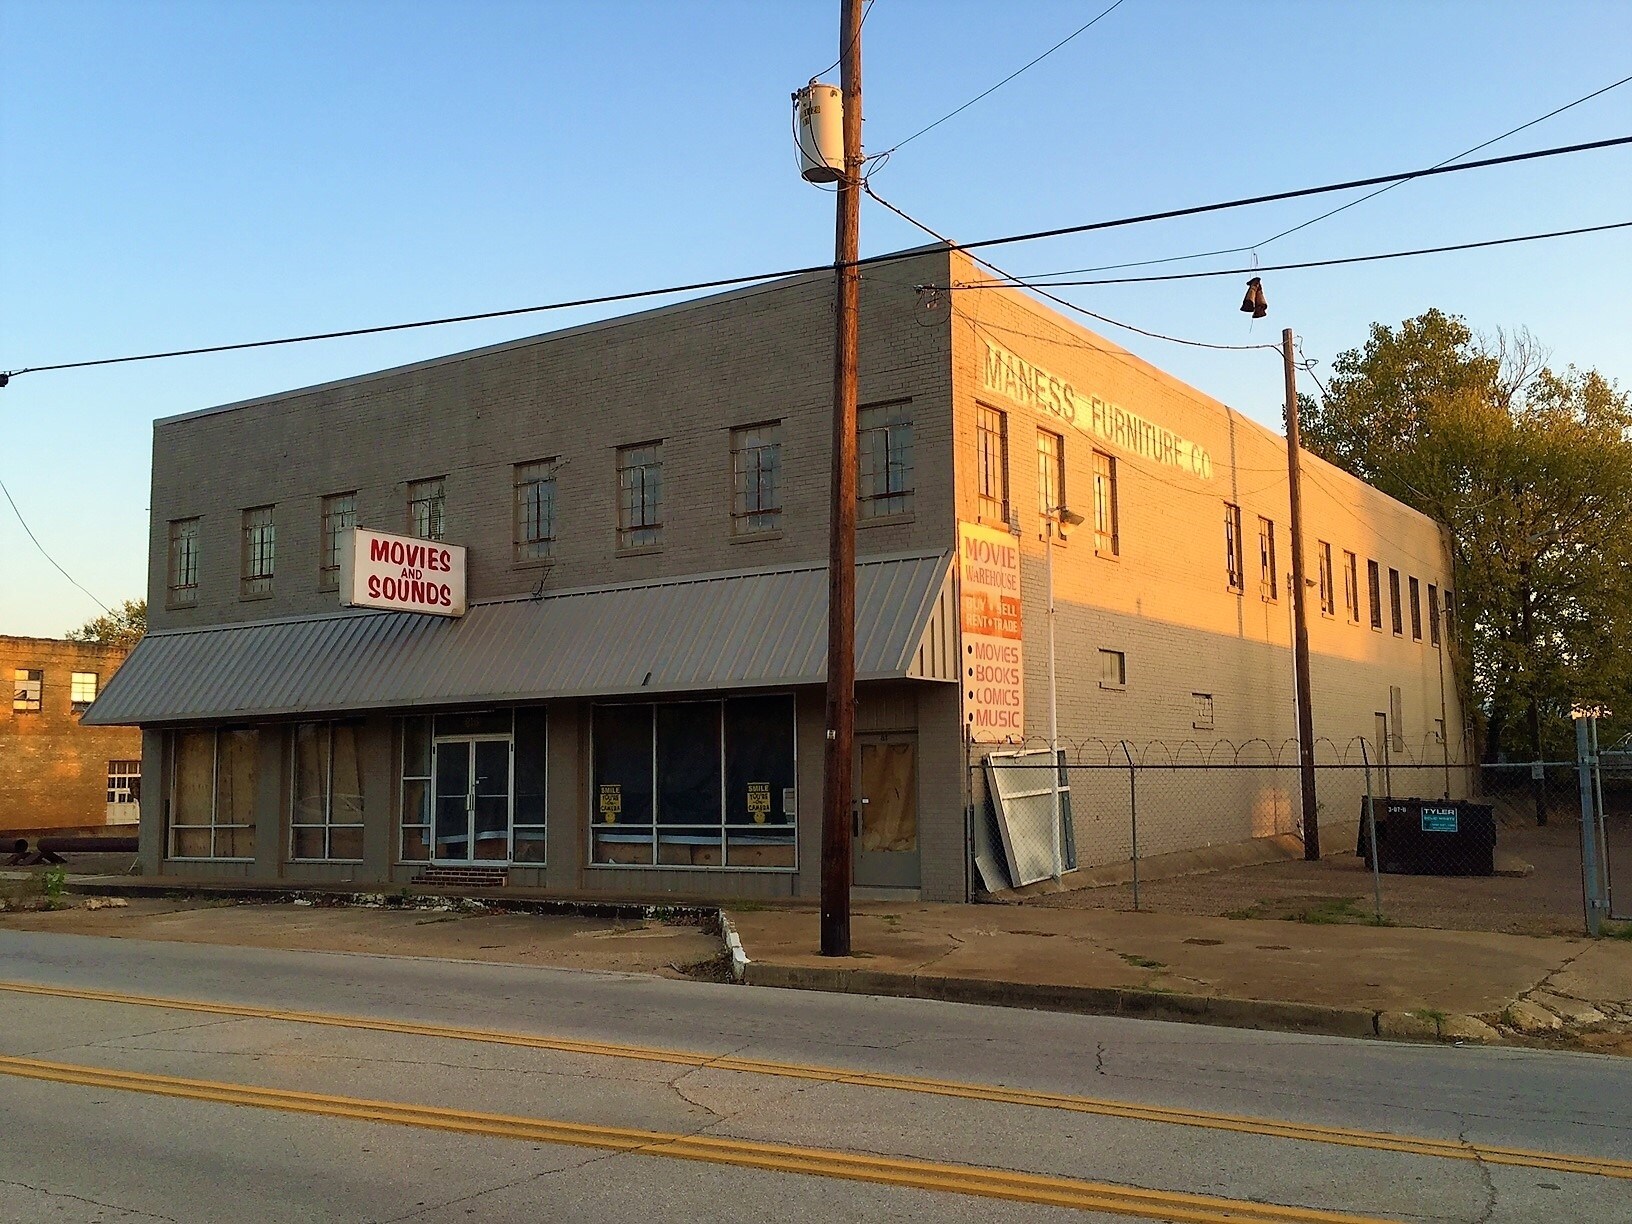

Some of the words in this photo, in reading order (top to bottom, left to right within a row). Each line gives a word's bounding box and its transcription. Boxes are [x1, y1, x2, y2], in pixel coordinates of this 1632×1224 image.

[984, 345, 1076, 424] MANESS
[1091, 395, 1183, 467] FURNITURE
[370, 538, 451, 572] MOVIES
[964, 536, 1017, 570] MOVIE
[401, 567, 423, 580] AND
[965, 564, 1017, 591] WAREHOUSE
[368, 574, 452, 607] SOUNDS
[993, 617, 1018, 633] TRADE
[975, 641, 1019, 664] MOVIES
[976, 664, 1020, 686] BOOKS
[976, 687, 1020, 707] COMICS
[976, 708, 1020, 728] MUSIC
